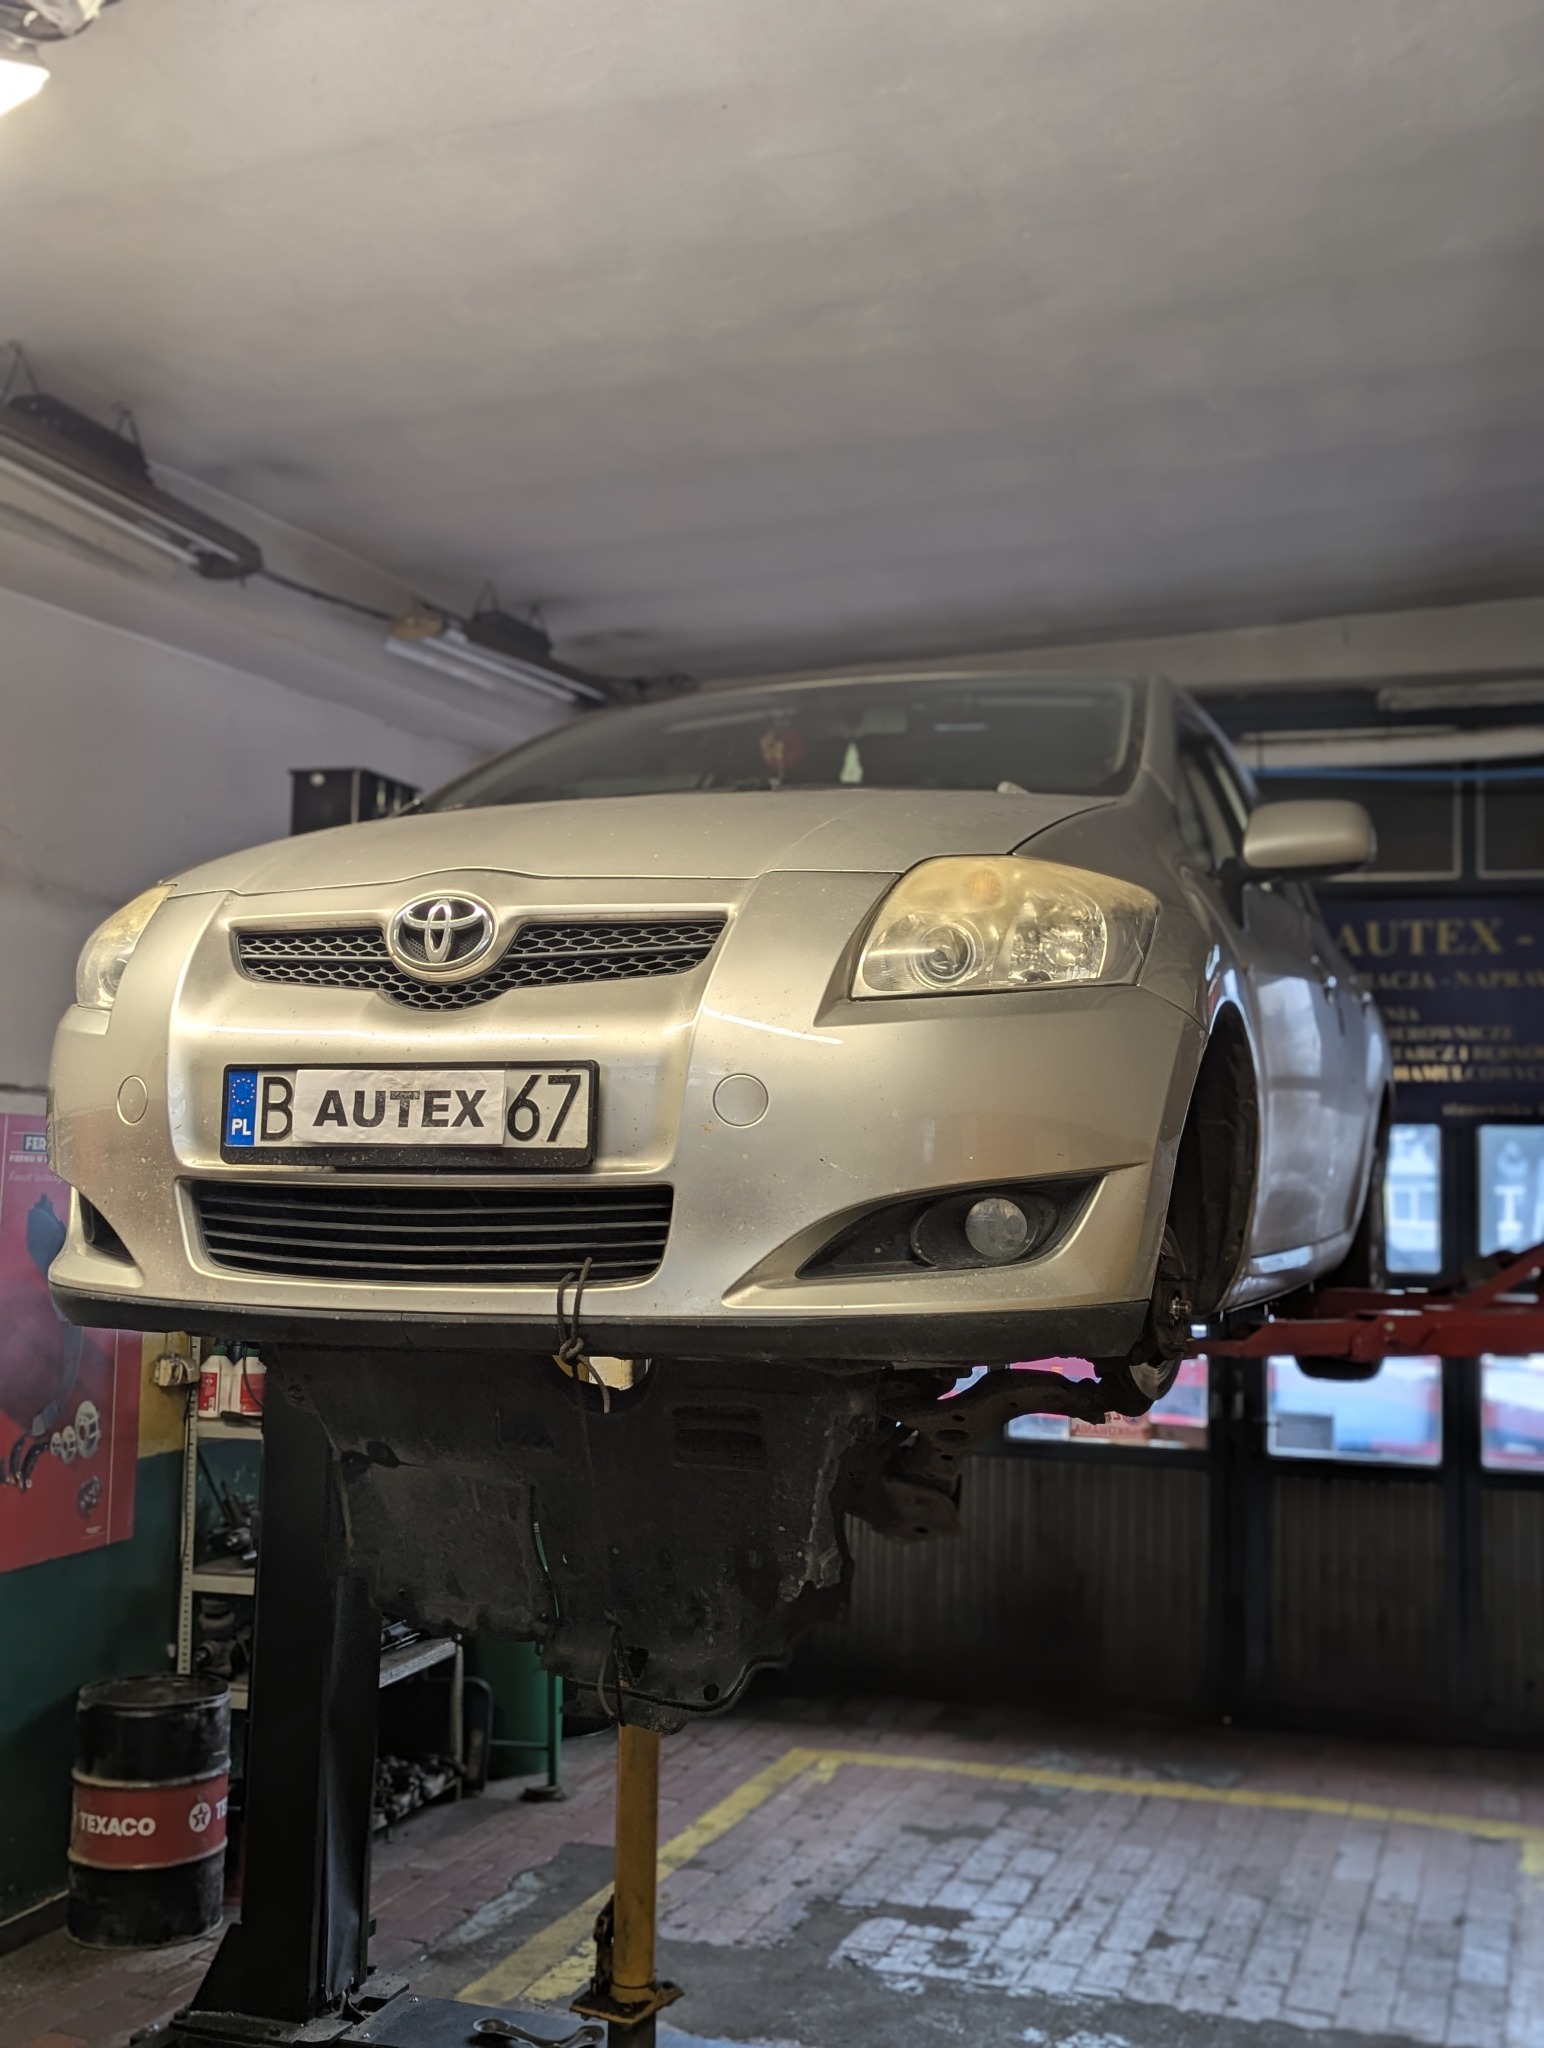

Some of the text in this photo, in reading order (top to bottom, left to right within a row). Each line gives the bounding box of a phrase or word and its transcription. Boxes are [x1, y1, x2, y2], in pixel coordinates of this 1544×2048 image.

[1336, 918, 1502, 956] AUTEX
[1356, 970, 1436, 989] RACJA
[1393, 1063, 1544, 1082] HAMULCOWYC
[312, 1089, 487, 1129] AUTEX
[507, 1074, 582, 1143] 67
[231, 1118, 252, 1137] PL
[25, 1136, 46, 1150] FER
[215, 1796, 229, 1820] TE
[79, 1811, 156, 1836] TEXACO
